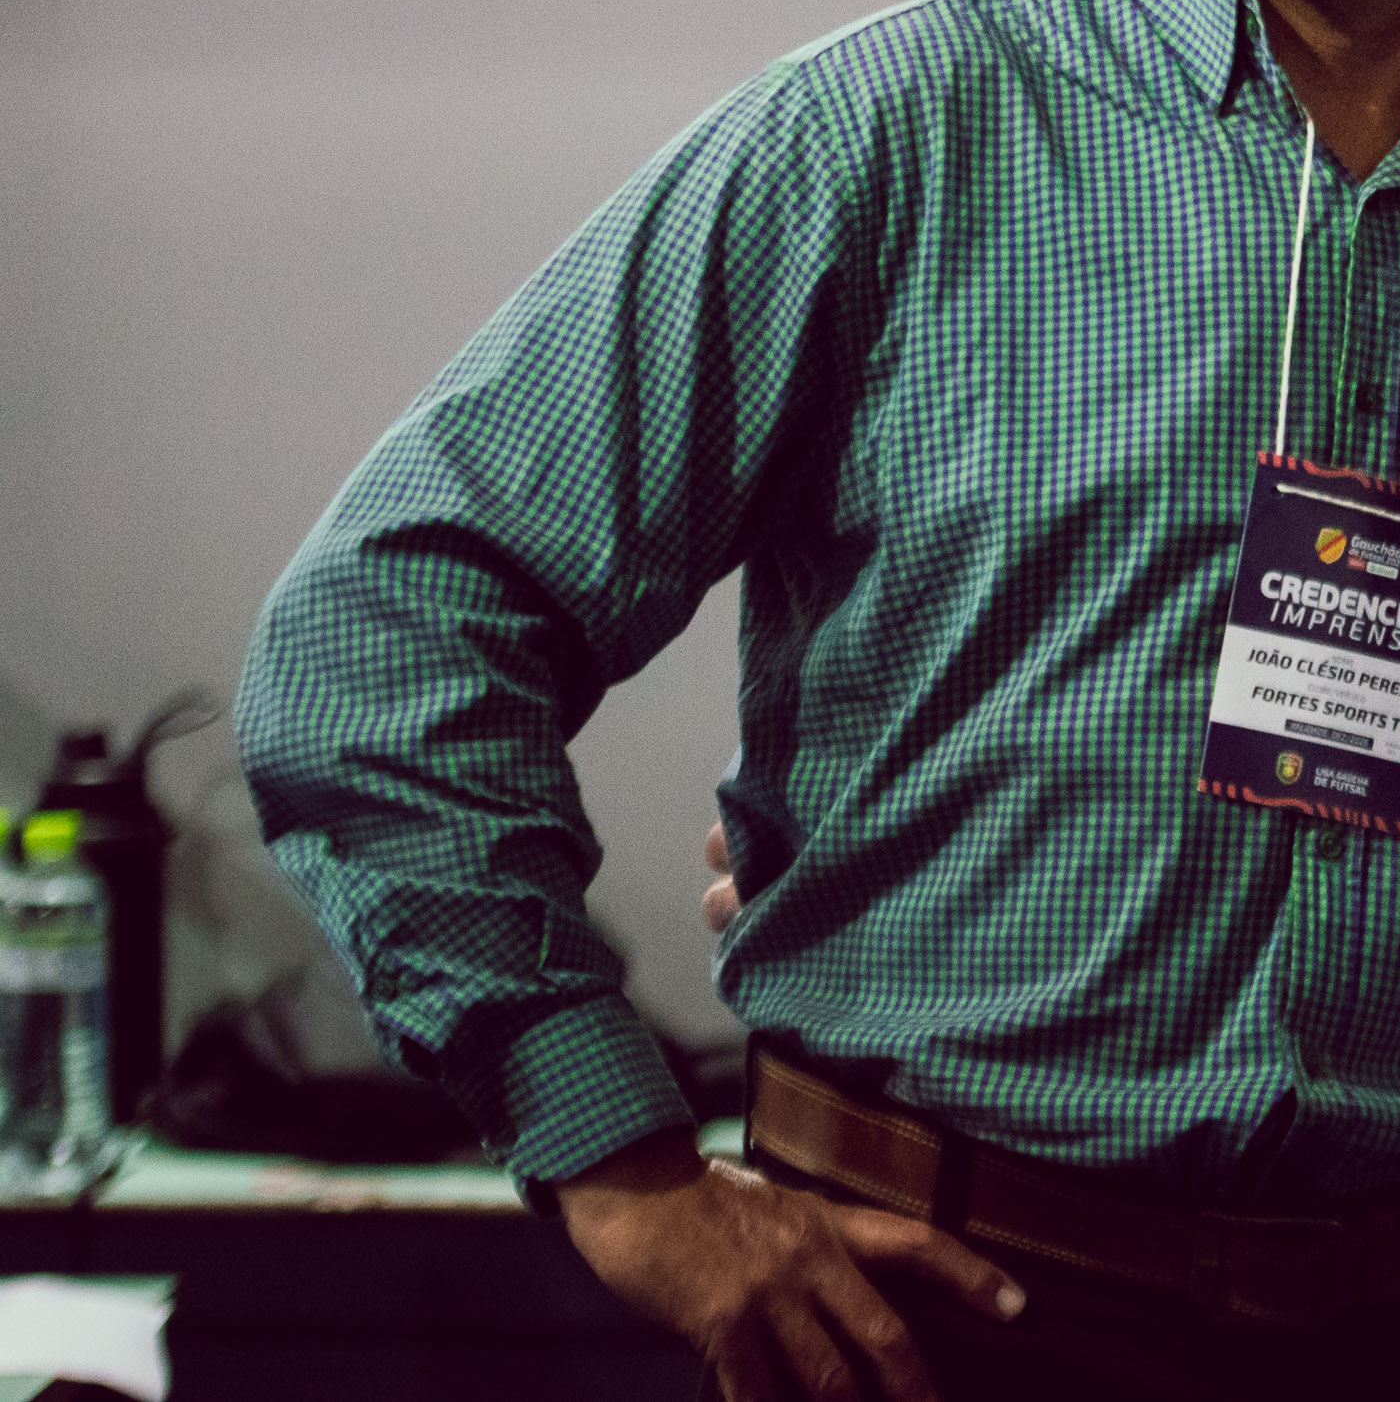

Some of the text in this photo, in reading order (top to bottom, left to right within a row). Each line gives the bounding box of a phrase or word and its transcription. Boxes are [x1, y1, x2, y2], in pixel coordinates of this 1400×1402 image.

[1248, 648, 1292, 670] JOÃO
[1297, 658, 1355, 683] CLÉSIO
[1252, 686, 1319, 711] FORTES
[1323, 701, 1388, 729] SPORTS
[1314, 776, 1367, 797] DE FUTSAL
